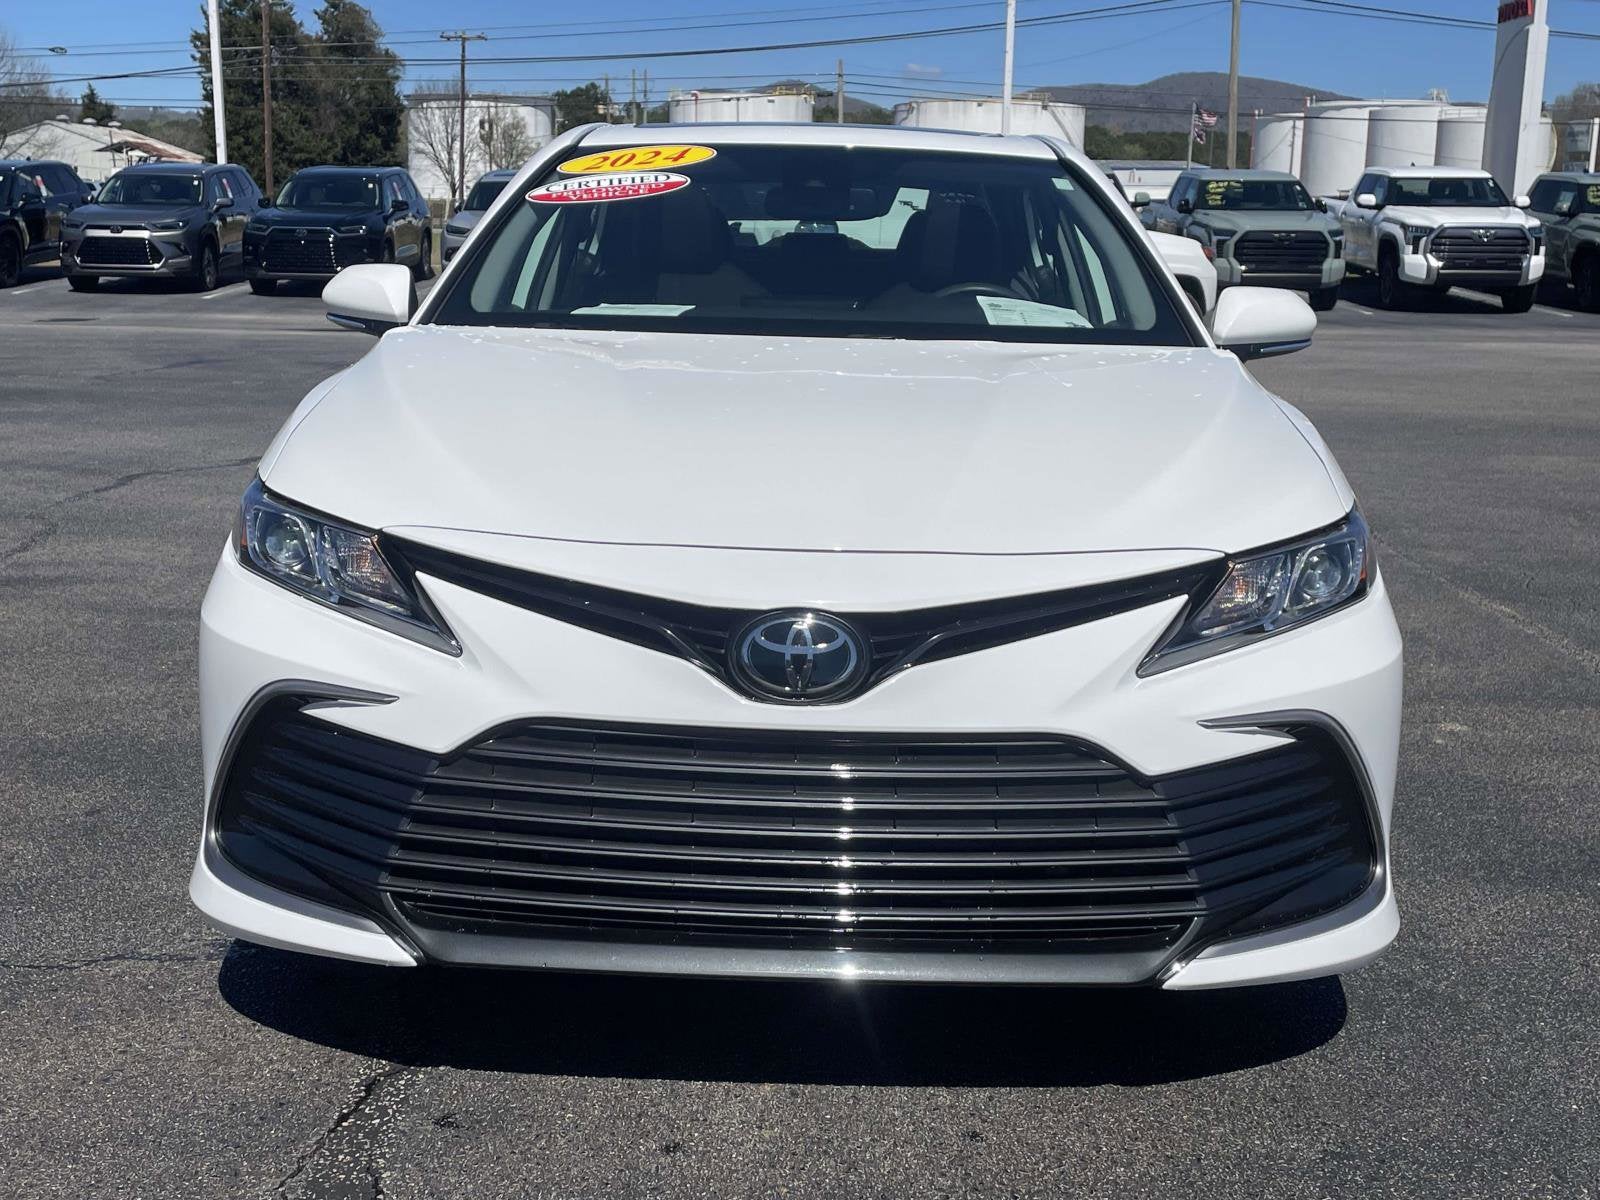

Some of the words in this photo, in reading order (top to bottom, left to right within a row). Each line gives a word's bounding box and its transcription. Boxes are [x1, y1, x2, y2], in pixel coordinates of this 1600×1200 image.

[583, 147, 693, 171] 2024
[545, 174, 671, 192] CERTIFIED
[551, 183, 665, 198] PRE-OWNED
[568, 188, 649, 200] VEHICLE
